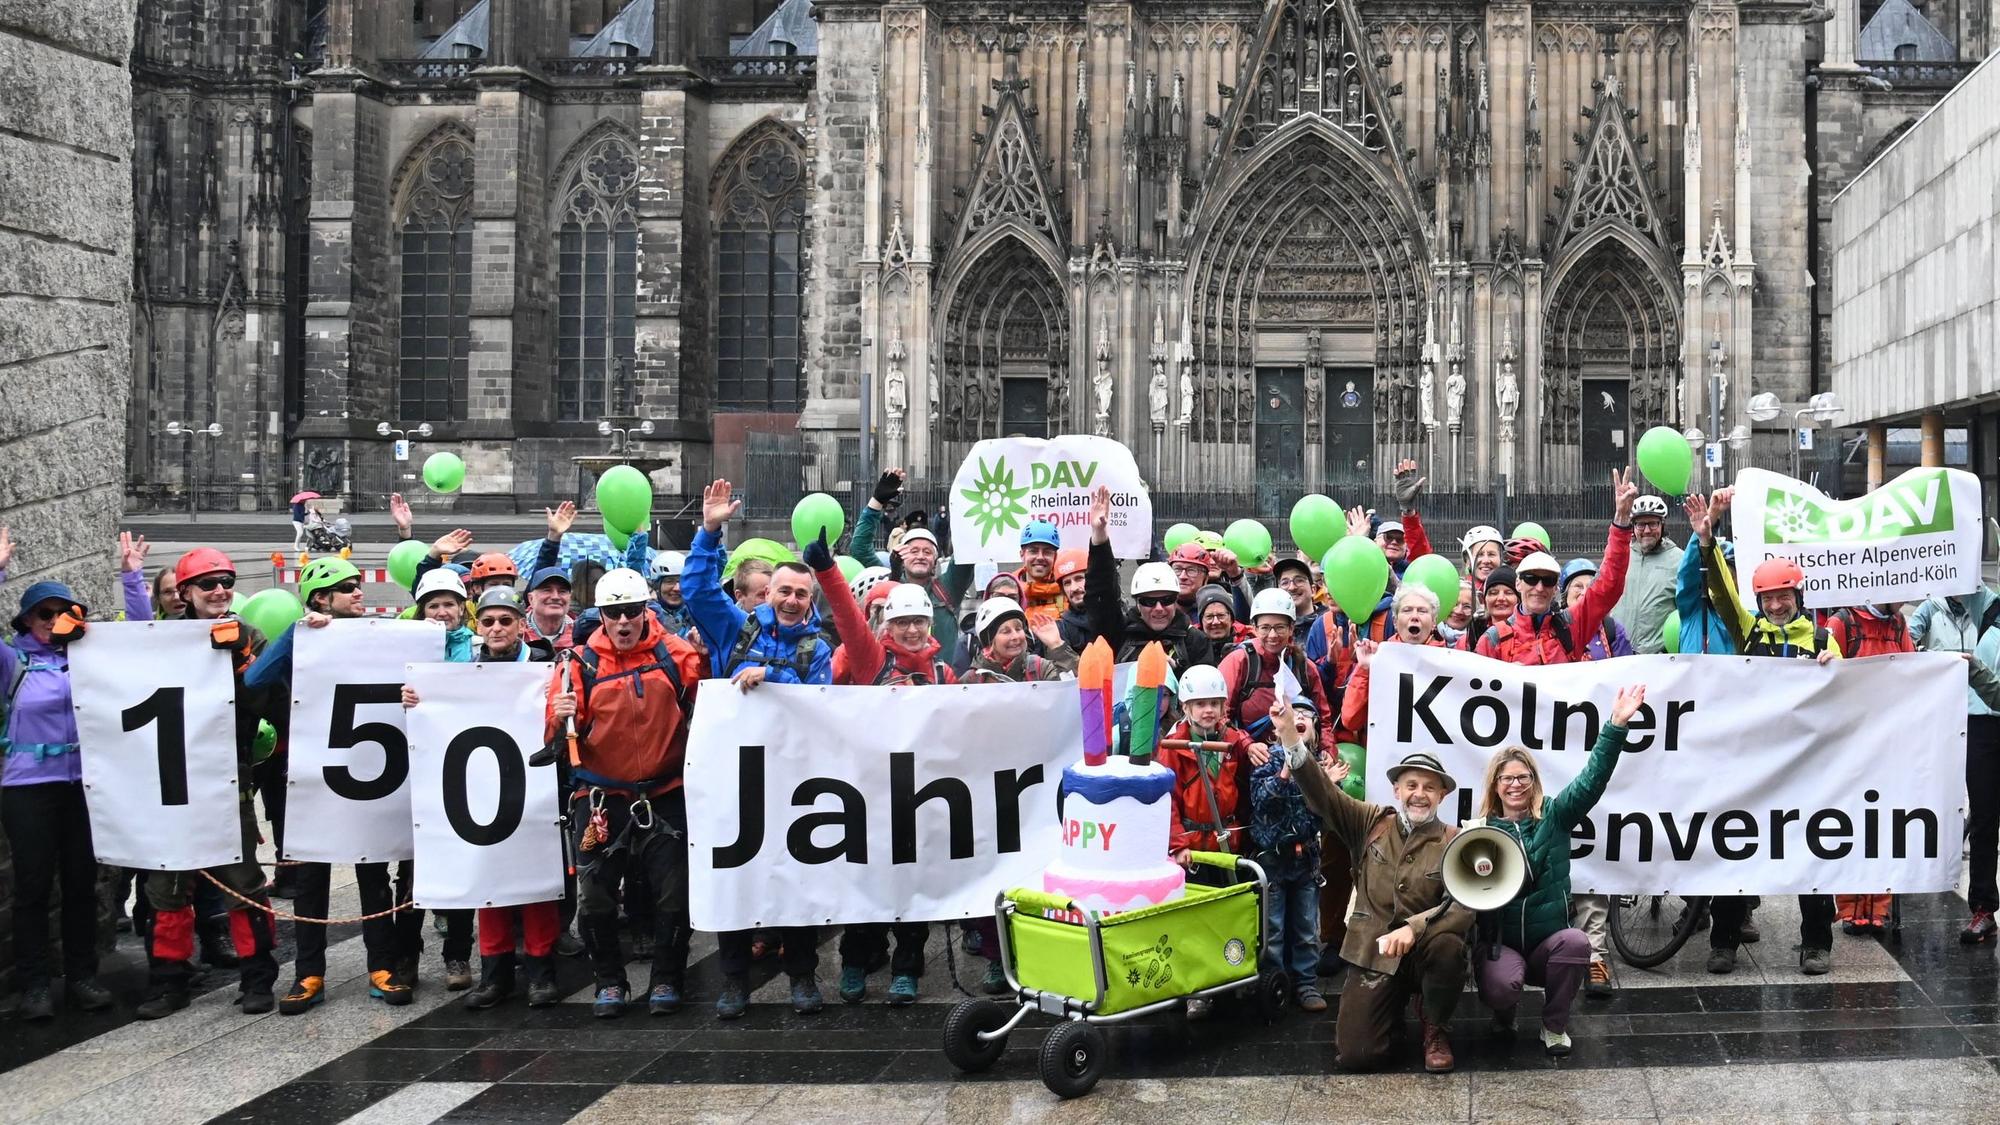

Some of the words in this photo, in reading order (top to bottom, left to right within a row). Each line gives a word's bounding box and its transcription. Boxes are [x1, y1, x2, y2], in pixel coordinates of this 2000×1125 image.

[1030, 492, 1138, 508] RheinlanKöln
[1031, 461, 1098, 489] DAV
[1062, 511, 1091, 528] JAH
[1827, 478, 1940, 540] DAV
[1764, 549, 1856, 569] tscher
[1861, 539, 1956, 567] Alpenverein
[1837, 563, 1958, 590] Rheinland-Köln
[322, 683, 410, 801] 5
[1397, 673, 1695, 753] Kölner
[122, 686, 189, 806] 1
[442, 726, 526, 846] 0
[711, 745, 1065, 869] Jahr
[1062, 816, 1117, 851] APPY
[1457, 788, 1938, 863] enverein
